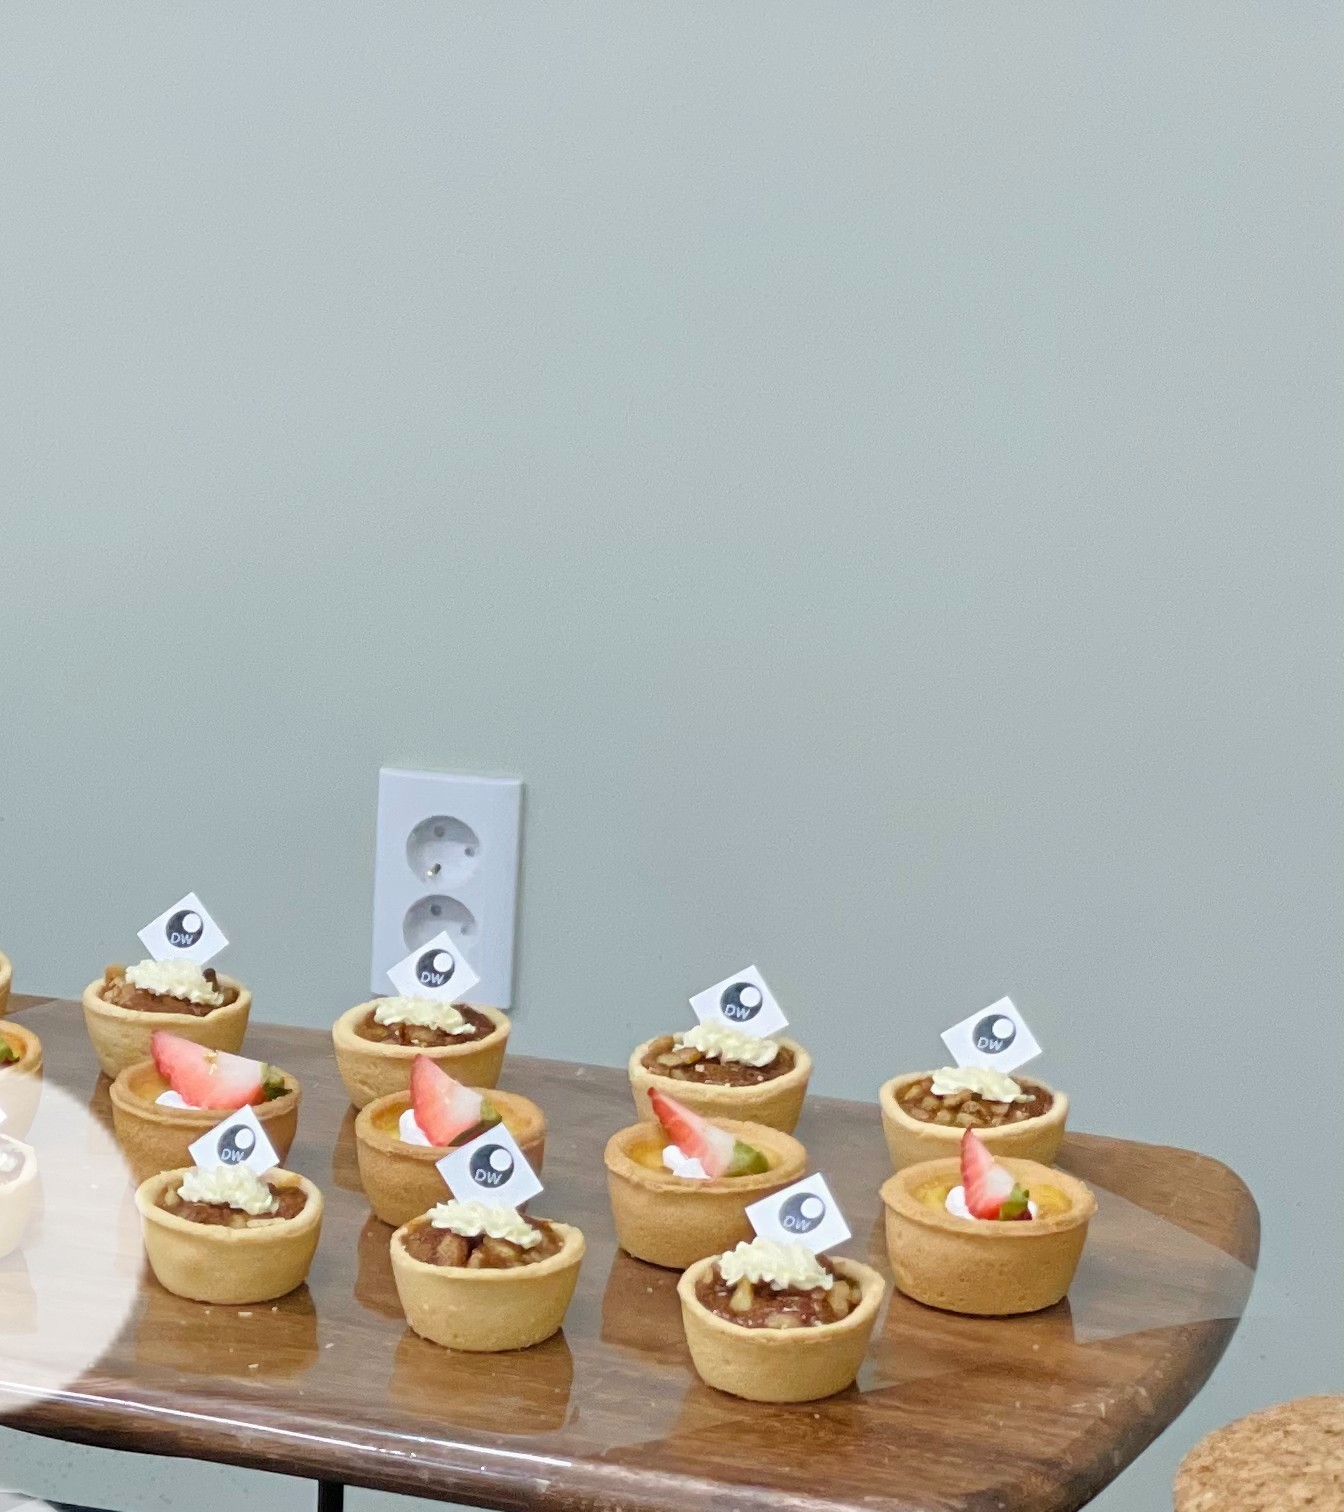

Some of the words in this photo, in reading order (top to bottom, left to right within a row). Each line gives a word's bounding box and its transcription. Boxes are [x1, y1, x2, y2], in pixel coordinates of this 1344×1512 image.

[171, 932, 193, 944] DW
[421, 971, 444, 985] DW
[725, 1004, 750, 1019] DW
[978, 1037, 1003, 1051] DW
[220, 1148, 244, 1161] DW
[475, 1168, 502, 1184] DW
[783, 1215, 811, 1231] DW
